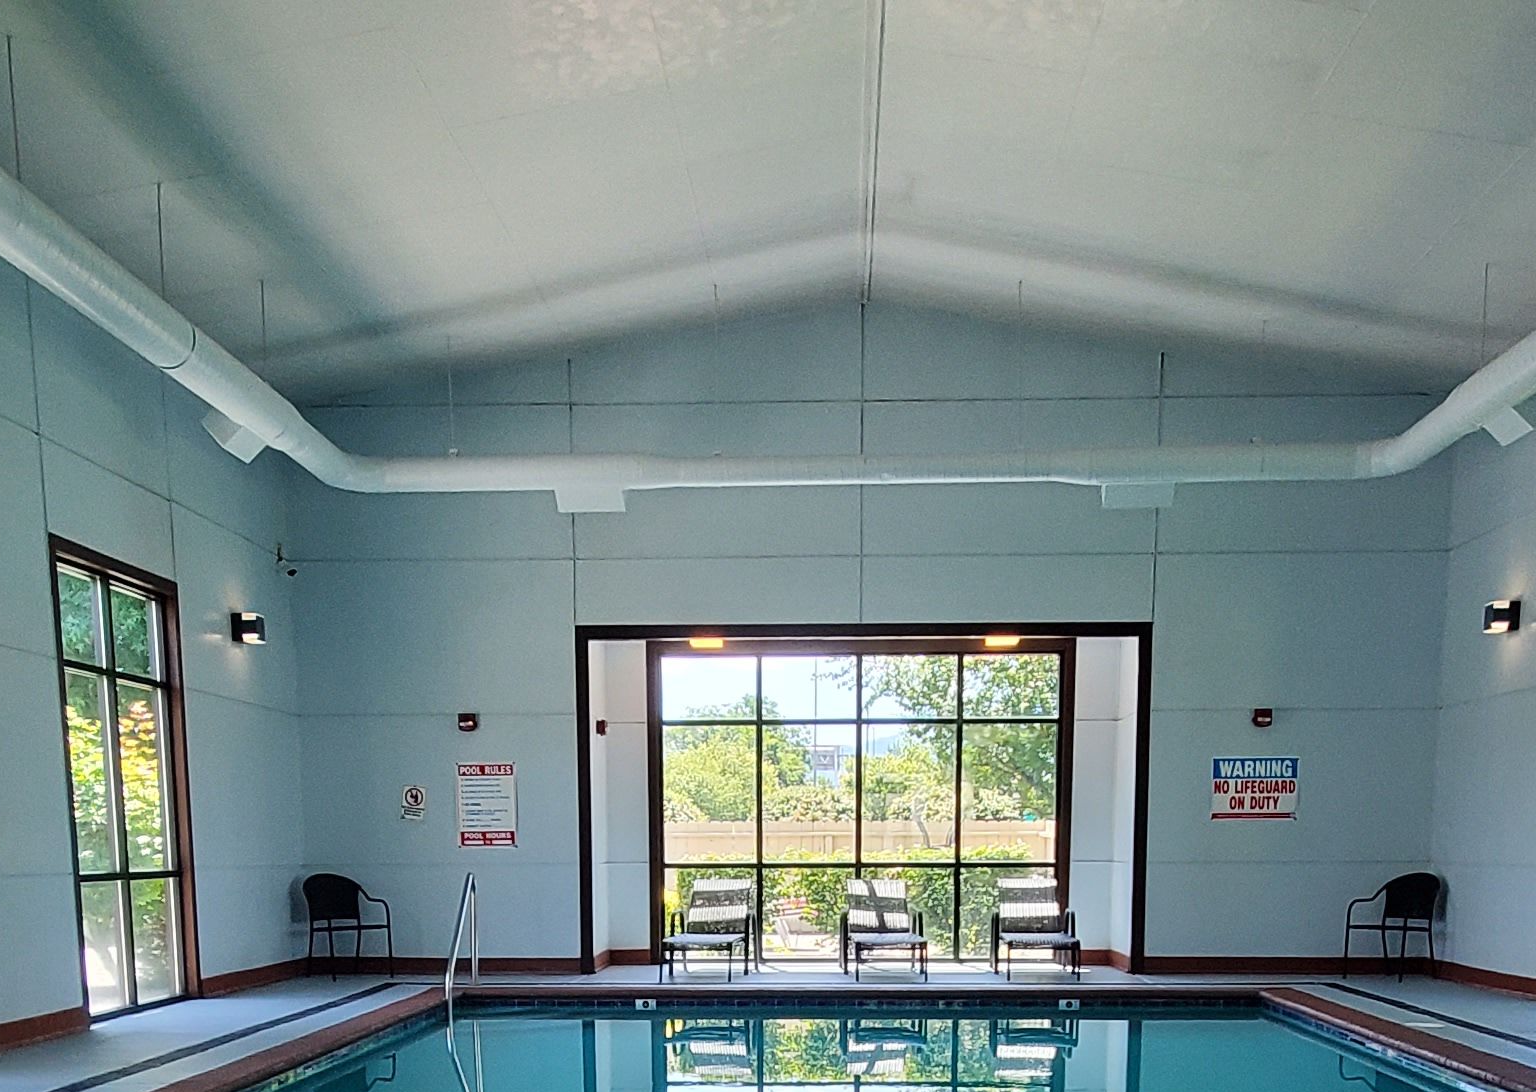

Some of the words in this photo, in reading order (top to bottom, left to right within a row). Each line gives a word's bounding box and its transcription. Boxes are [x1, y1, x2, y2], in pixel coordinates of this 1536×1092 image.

[459, 766, 483, 775] POOL
[484, 765, 512, 775] RULES
[1219, 760, 1293, 777] WARNING
[1213, 780, 1230, 794] NO
[1234, 780, 1296, 794] LIFEGUARD
[1229, 796, 1245, 810] ON
[1249, 796, 1280, 810] DUTY
